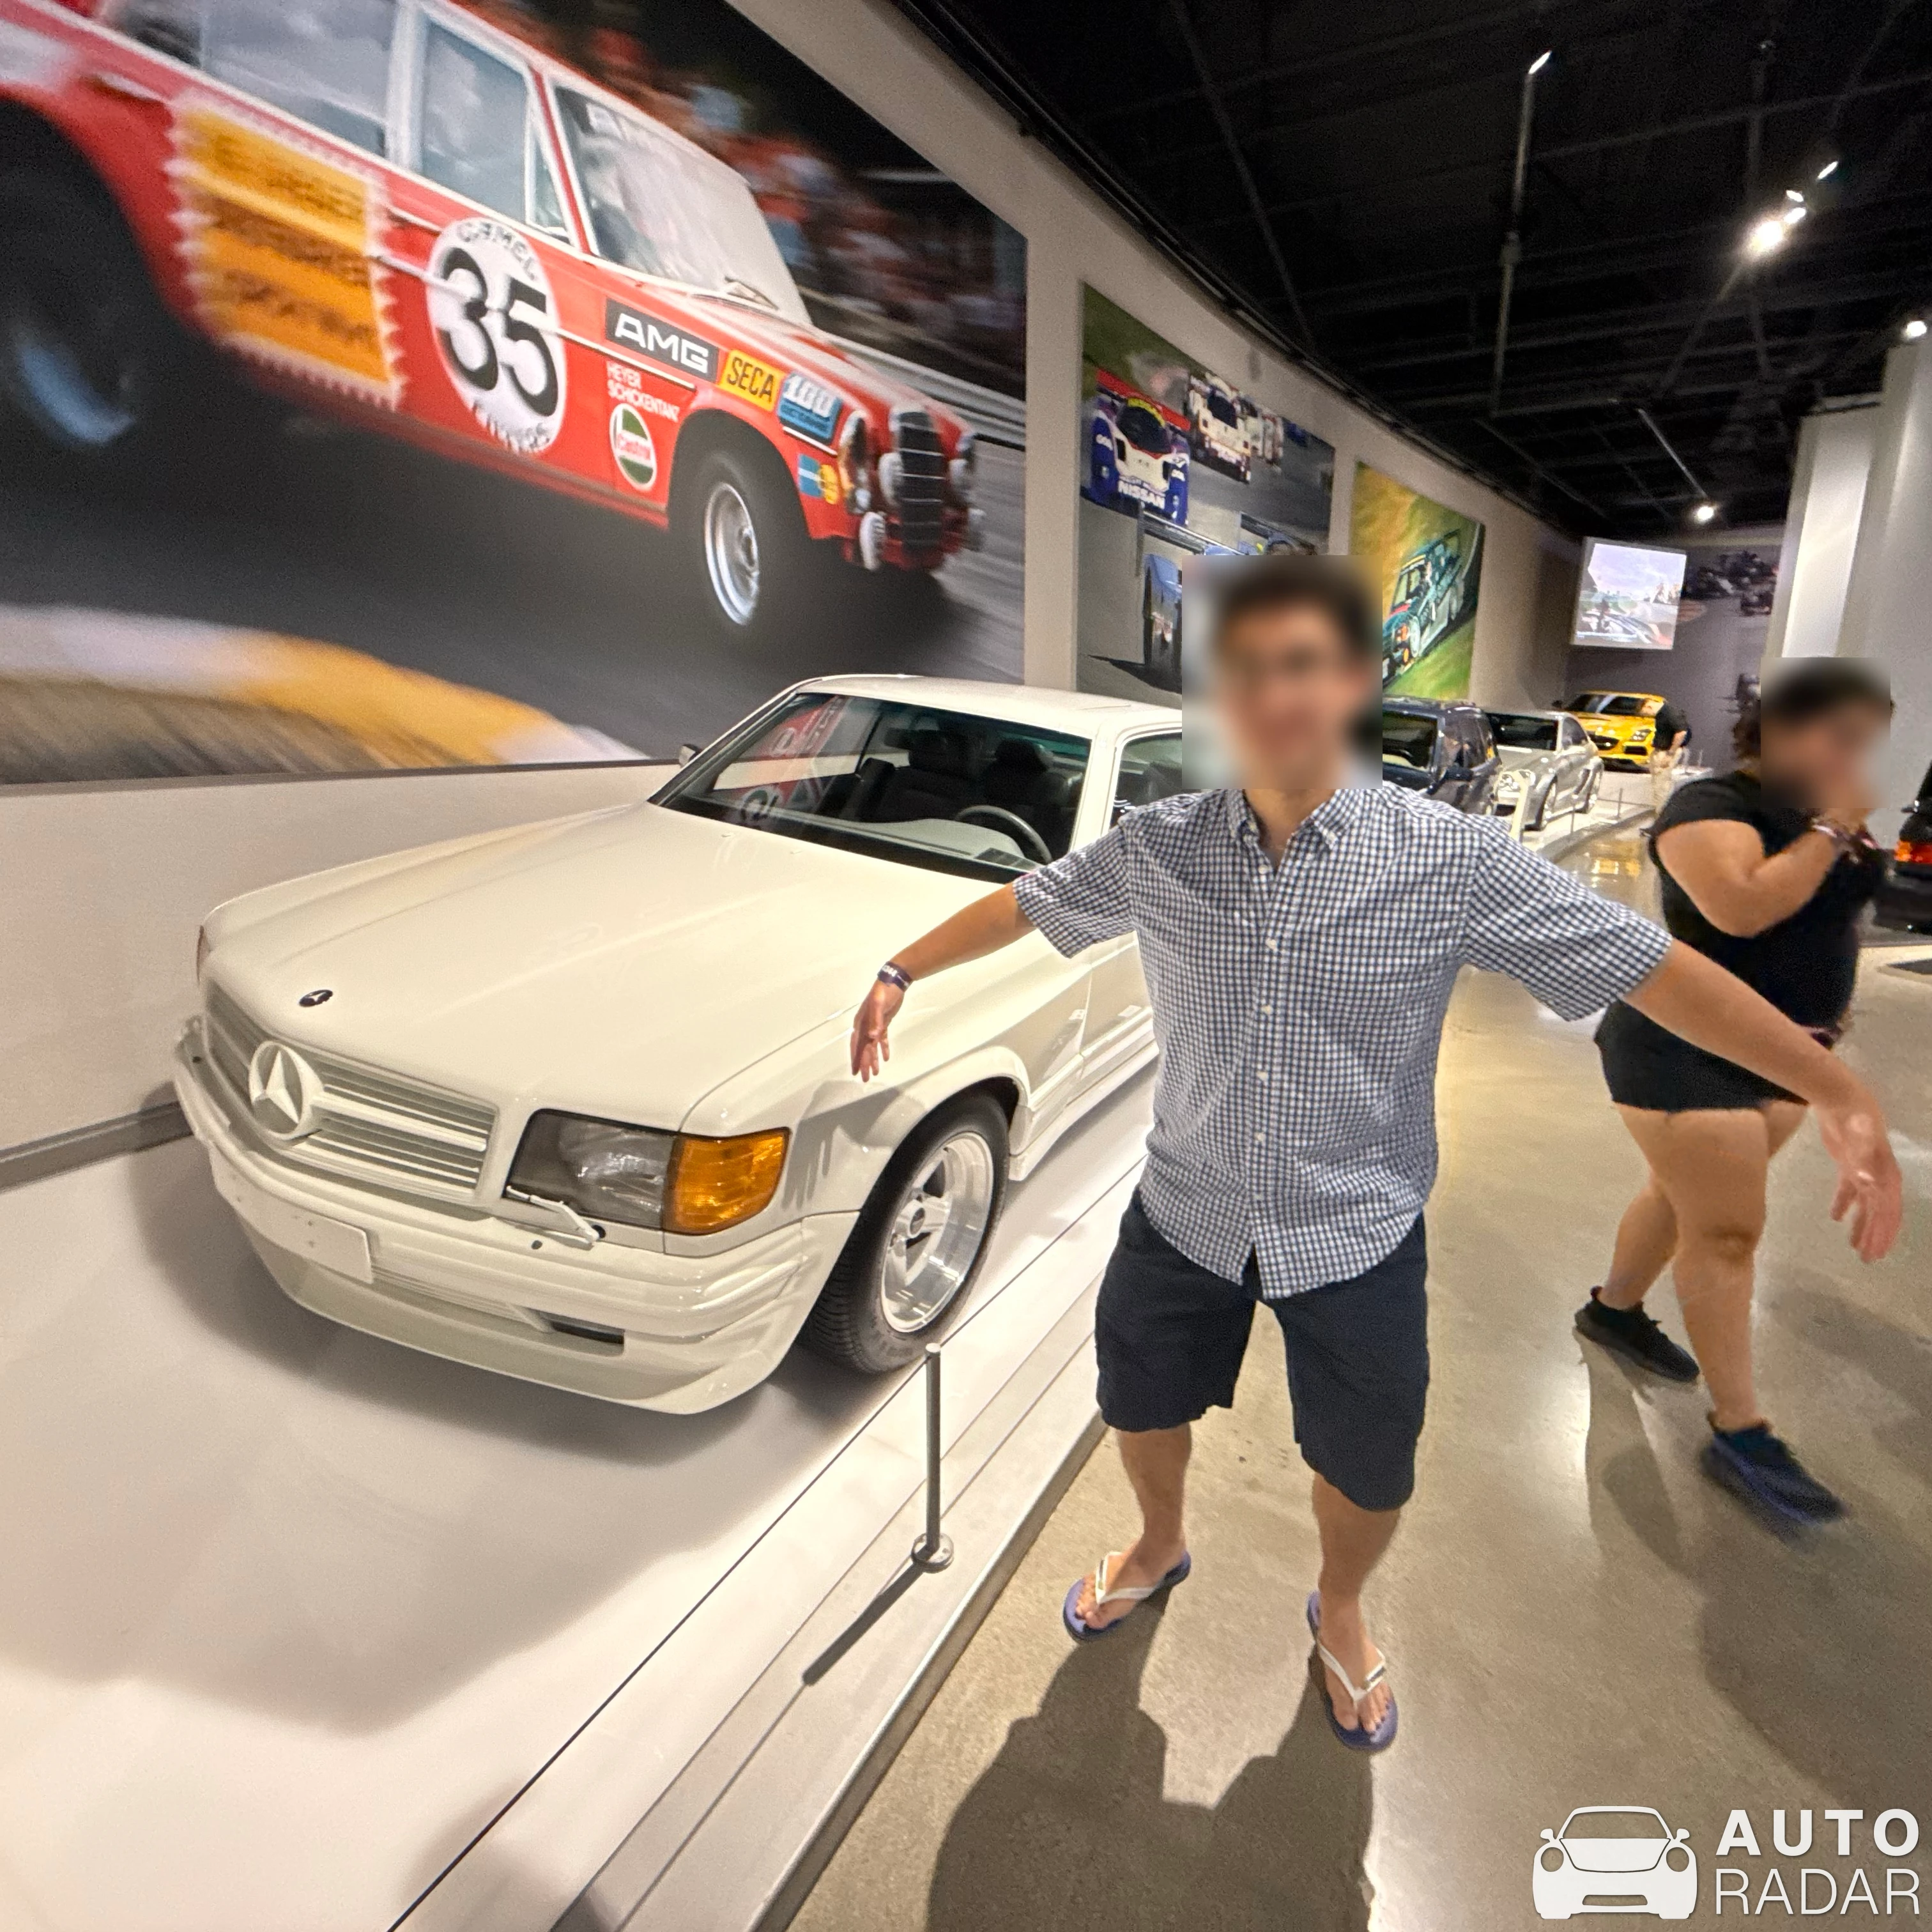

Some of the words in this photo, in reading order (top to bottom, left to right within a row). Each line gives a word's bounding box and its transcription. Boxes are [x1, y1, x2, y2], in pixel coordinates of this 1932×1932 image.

[434, 247, 559, 417] 35
[614, 312, 709, 374] AMG
[726, 356, 775, 403] SECA
[1118, 479, 1165, 509] NISSAN
